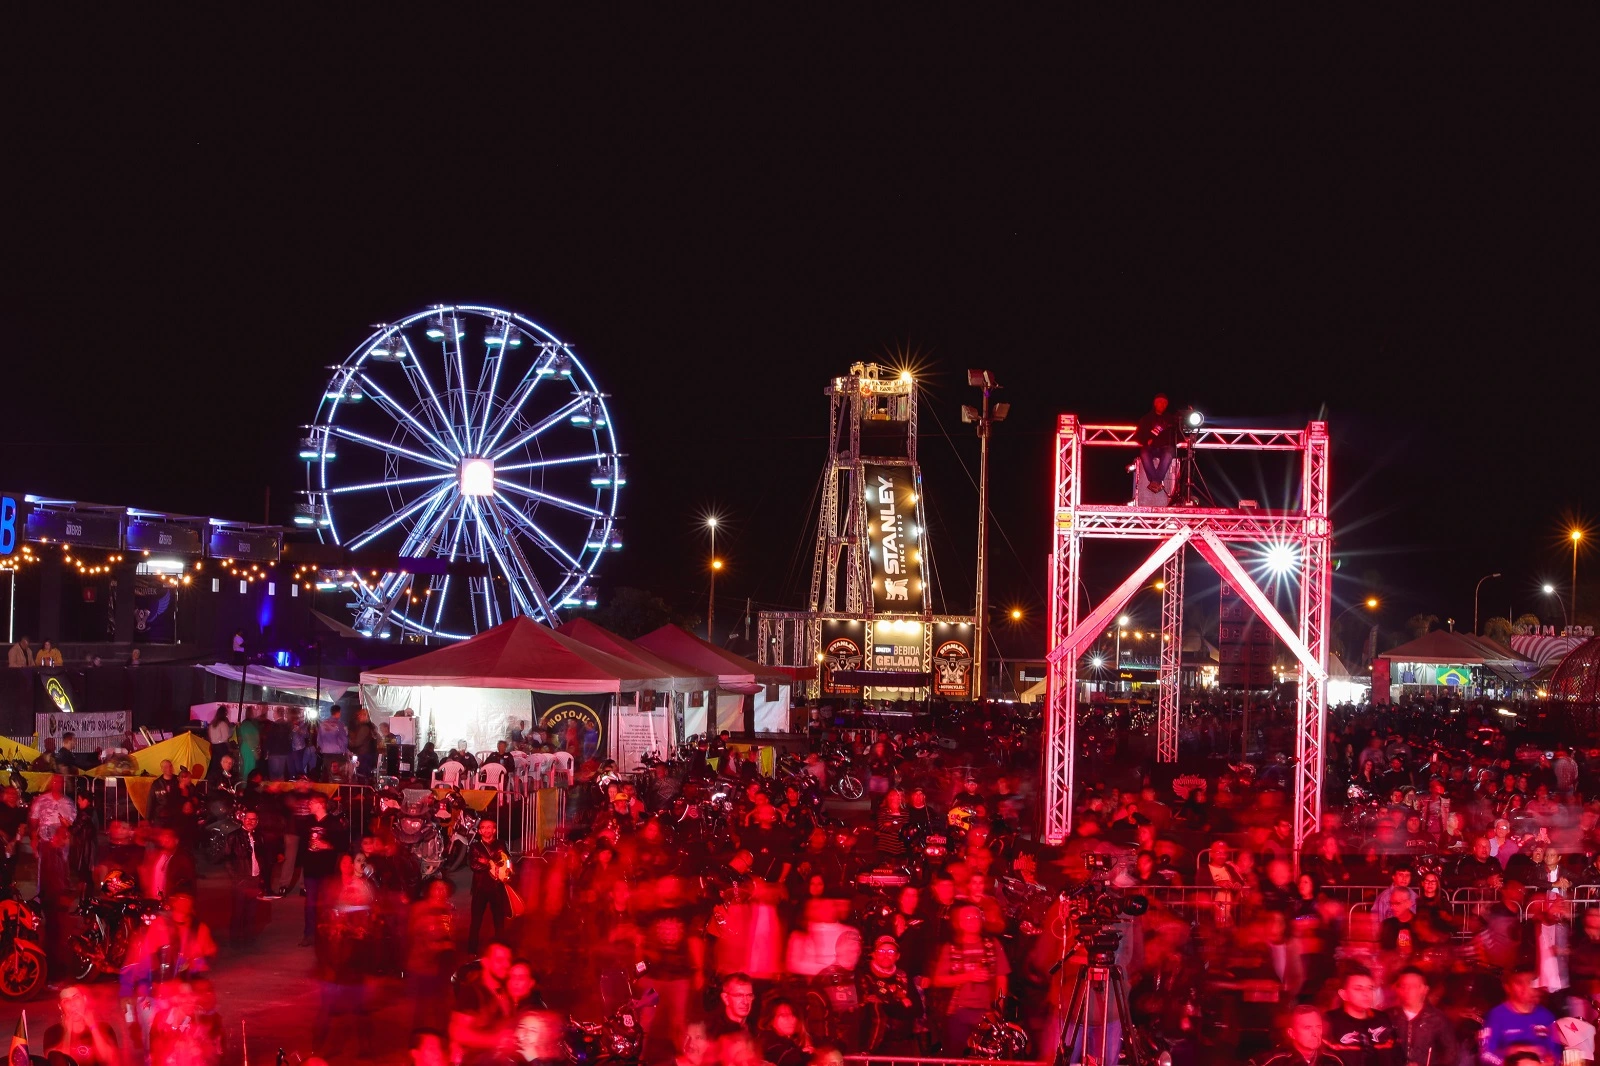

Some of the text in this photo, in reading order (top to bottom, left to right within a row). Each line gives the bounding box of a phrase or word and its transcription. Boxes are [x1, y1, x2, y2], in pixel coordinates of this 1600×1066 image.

[877, 475, 899, 575] STANLEY
[829, 640, 857, 652] STANLEY
[893, 645, 921, 656] BEBIDA
[939, 643, 967, 655] STANLEY
[875, 655, 920, 667] GELADA
